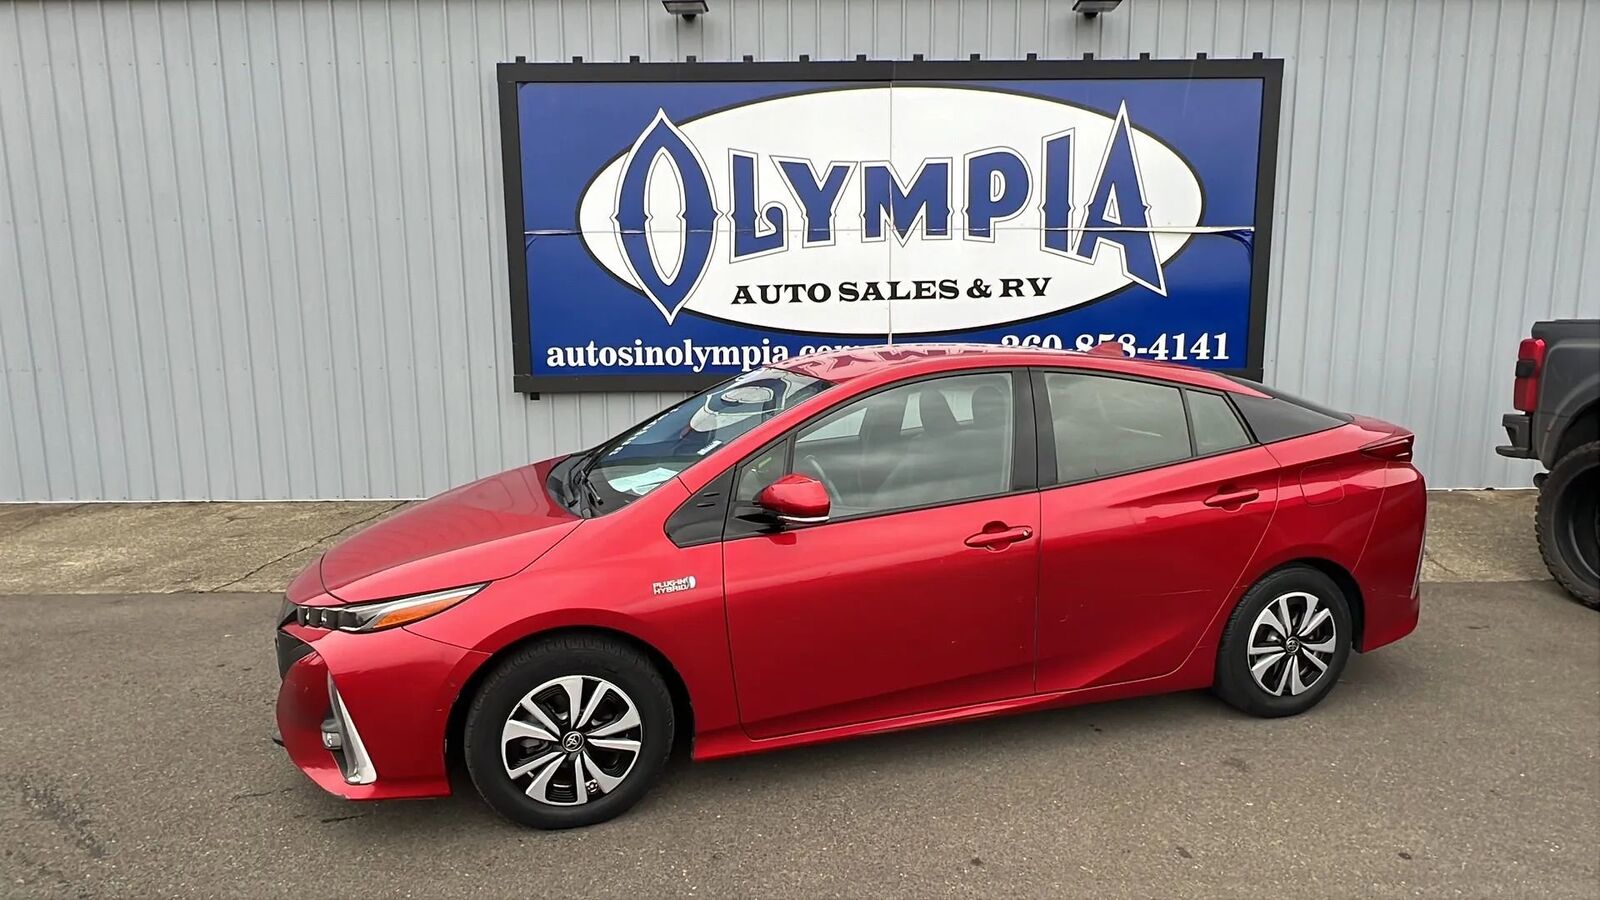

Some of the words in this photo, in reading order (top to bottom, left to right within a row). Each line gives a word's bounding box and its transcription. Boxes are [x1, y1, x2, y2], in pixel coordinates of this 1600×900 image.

[613, 99, 1167, 327] OLYMPIA
[730, 282, 832, 305] AUTO
[838, 279, 960, 302] SALES
[966, 278, 992, 299] &
[998, 276, 1053, 298] RV
